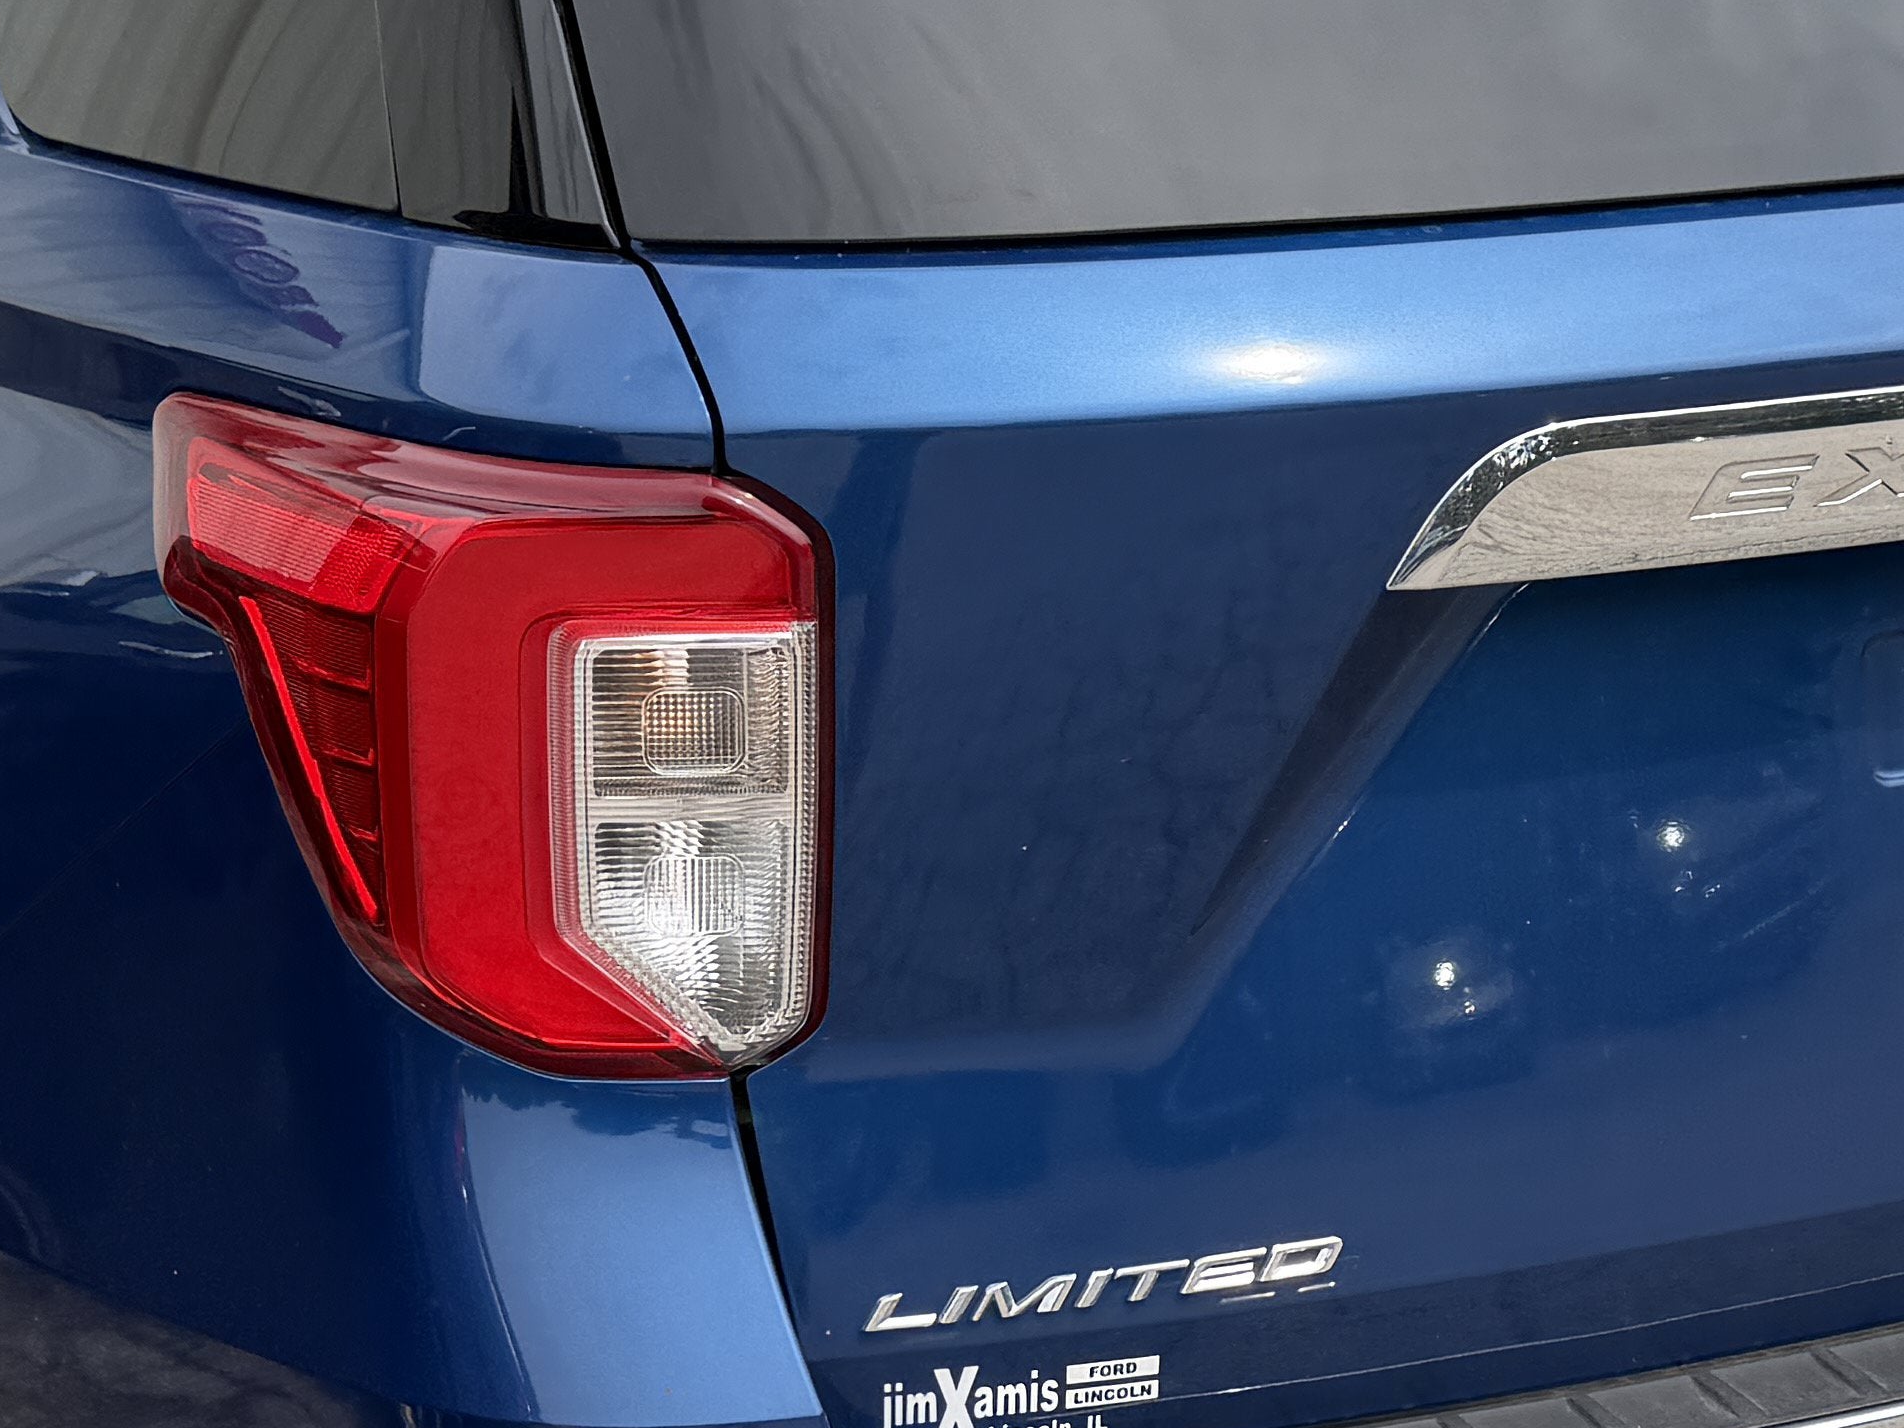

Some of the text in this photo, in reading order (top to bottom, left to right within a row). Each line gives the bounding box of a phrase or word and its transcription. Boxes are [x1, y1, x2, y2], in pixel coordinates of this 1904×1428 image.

[863, 1235, 1344, 1332] LIMITED
[1088, 1361, 1138, 1379] FORD
[1073, 1383, 1153, 1405] LINCOLN
